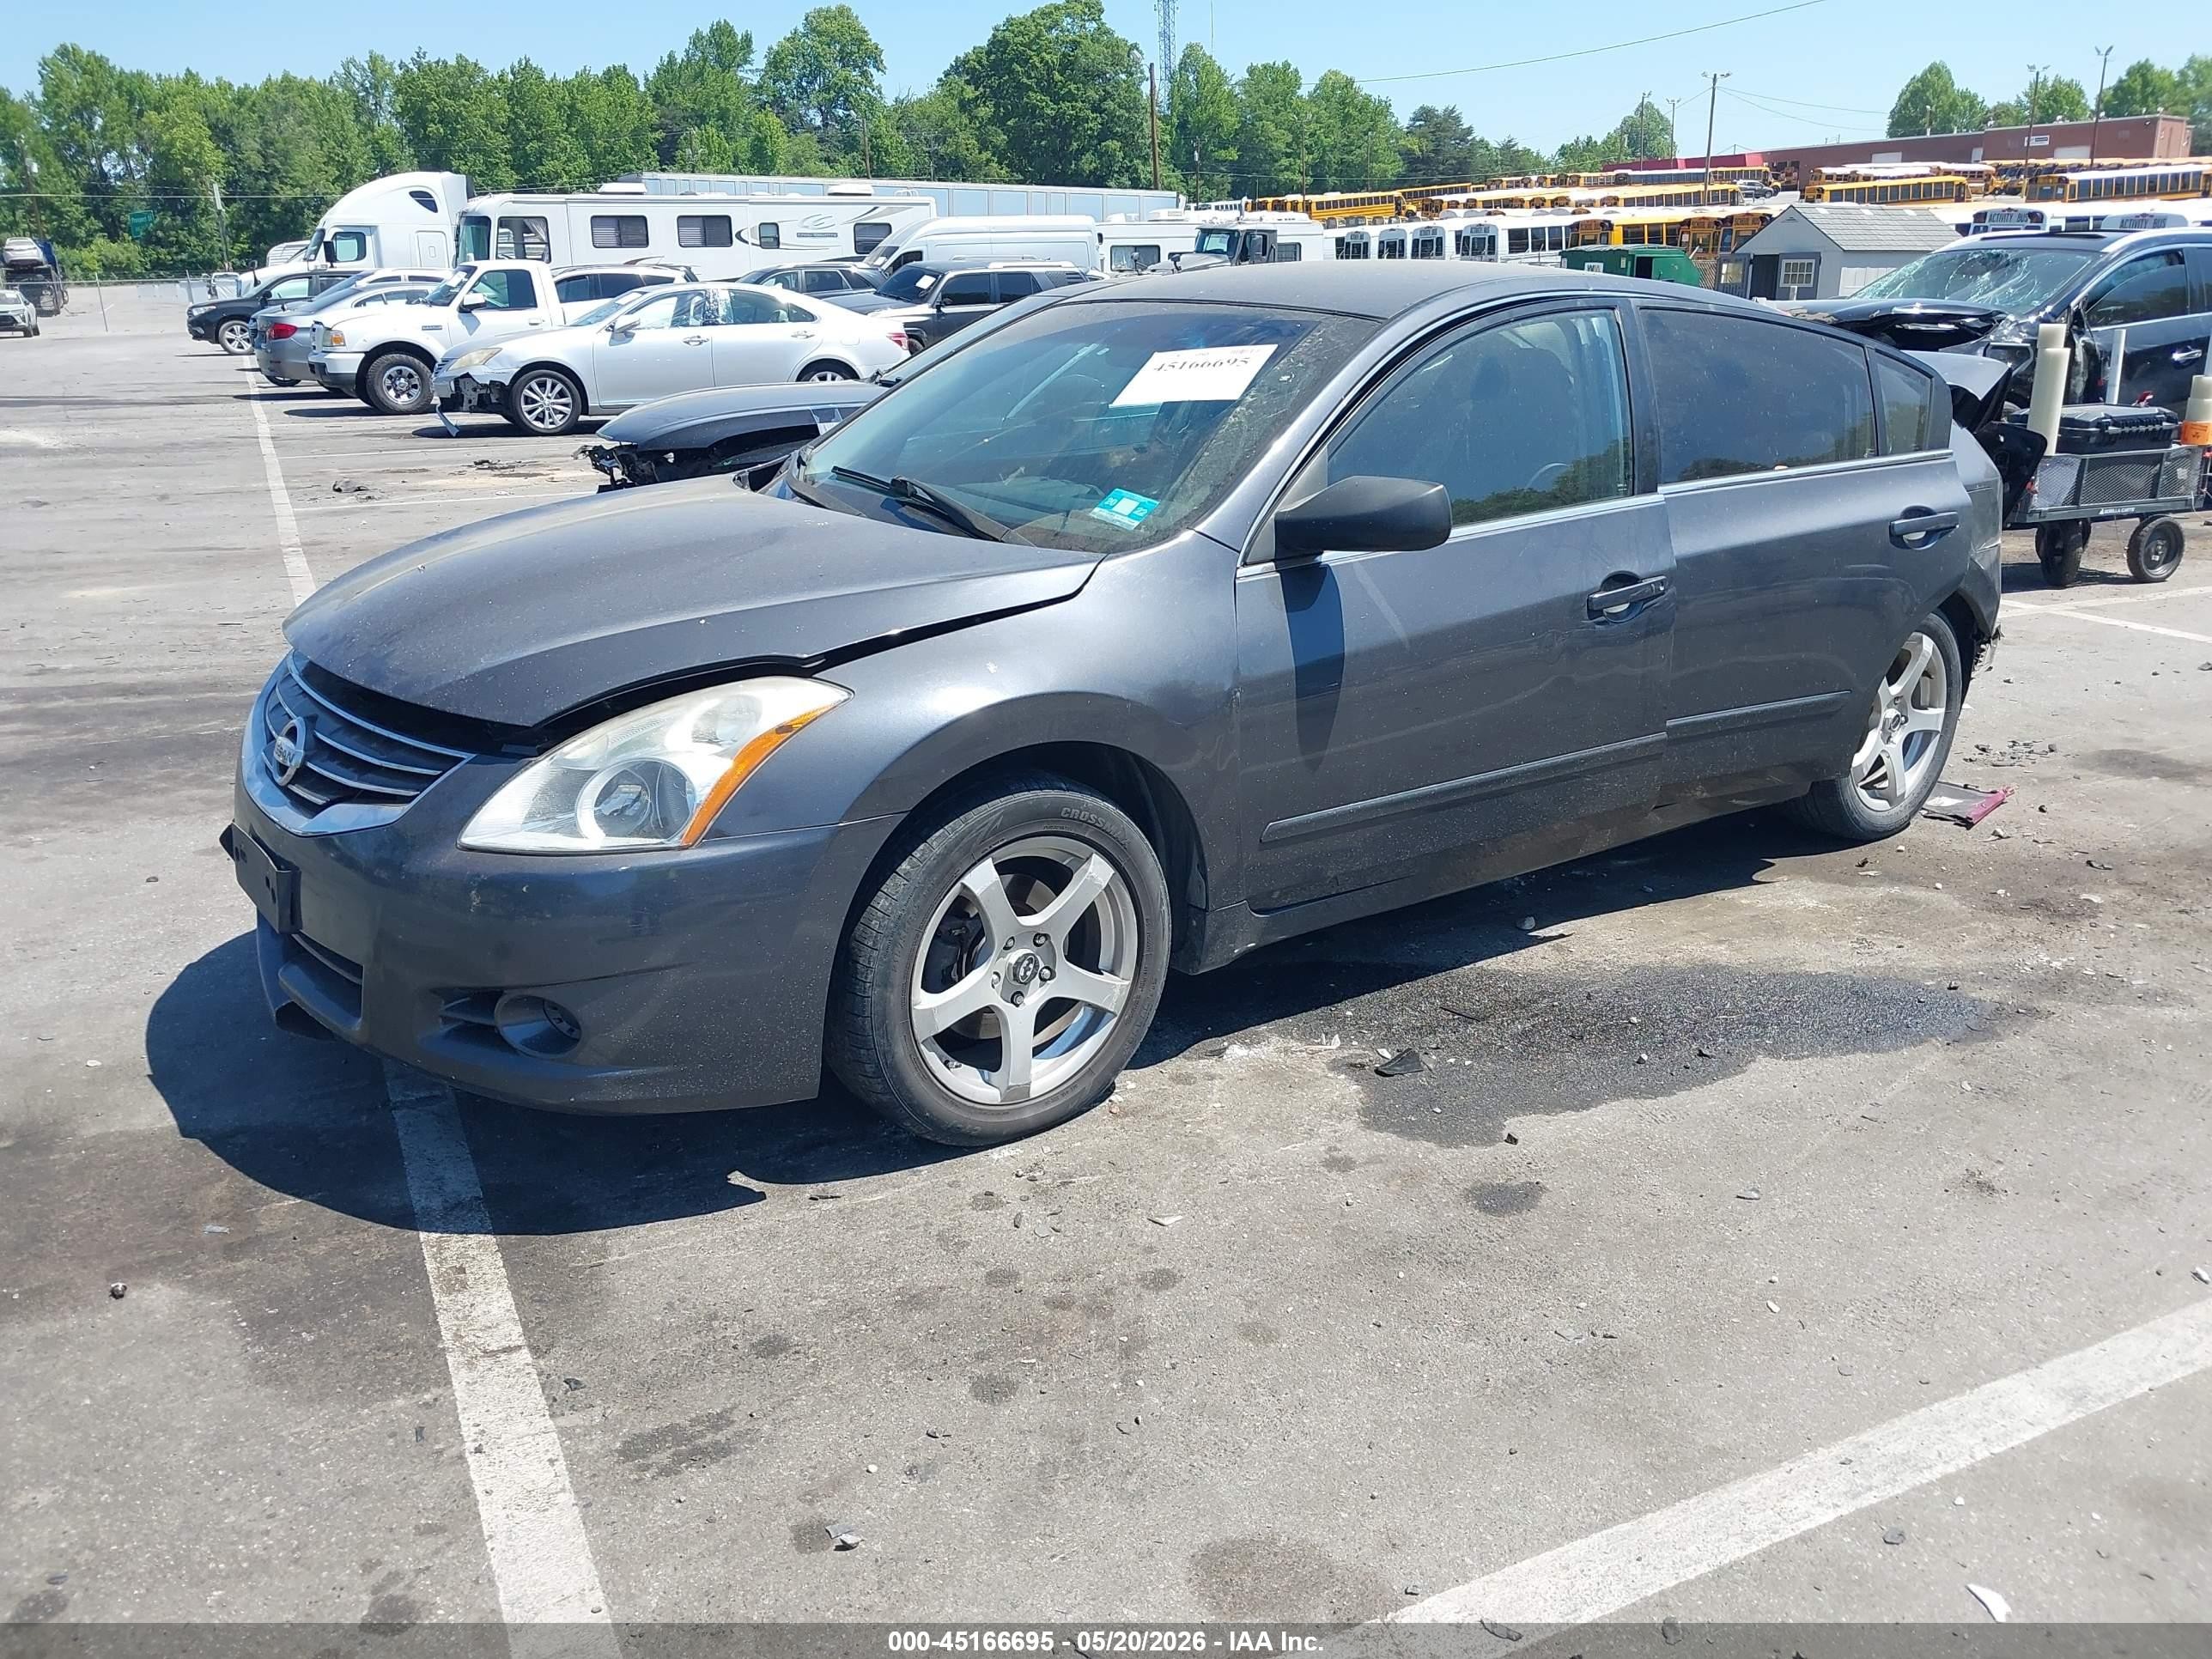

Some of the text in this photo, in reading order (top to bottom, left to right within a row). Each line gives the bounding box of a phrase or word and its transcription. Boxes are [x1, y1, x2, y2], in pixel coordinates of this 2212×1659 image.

[1988, 212, 2029, 222] ACTIVITY BUS
[2118, 217, 2167, 229] ACTIVITY BUS
